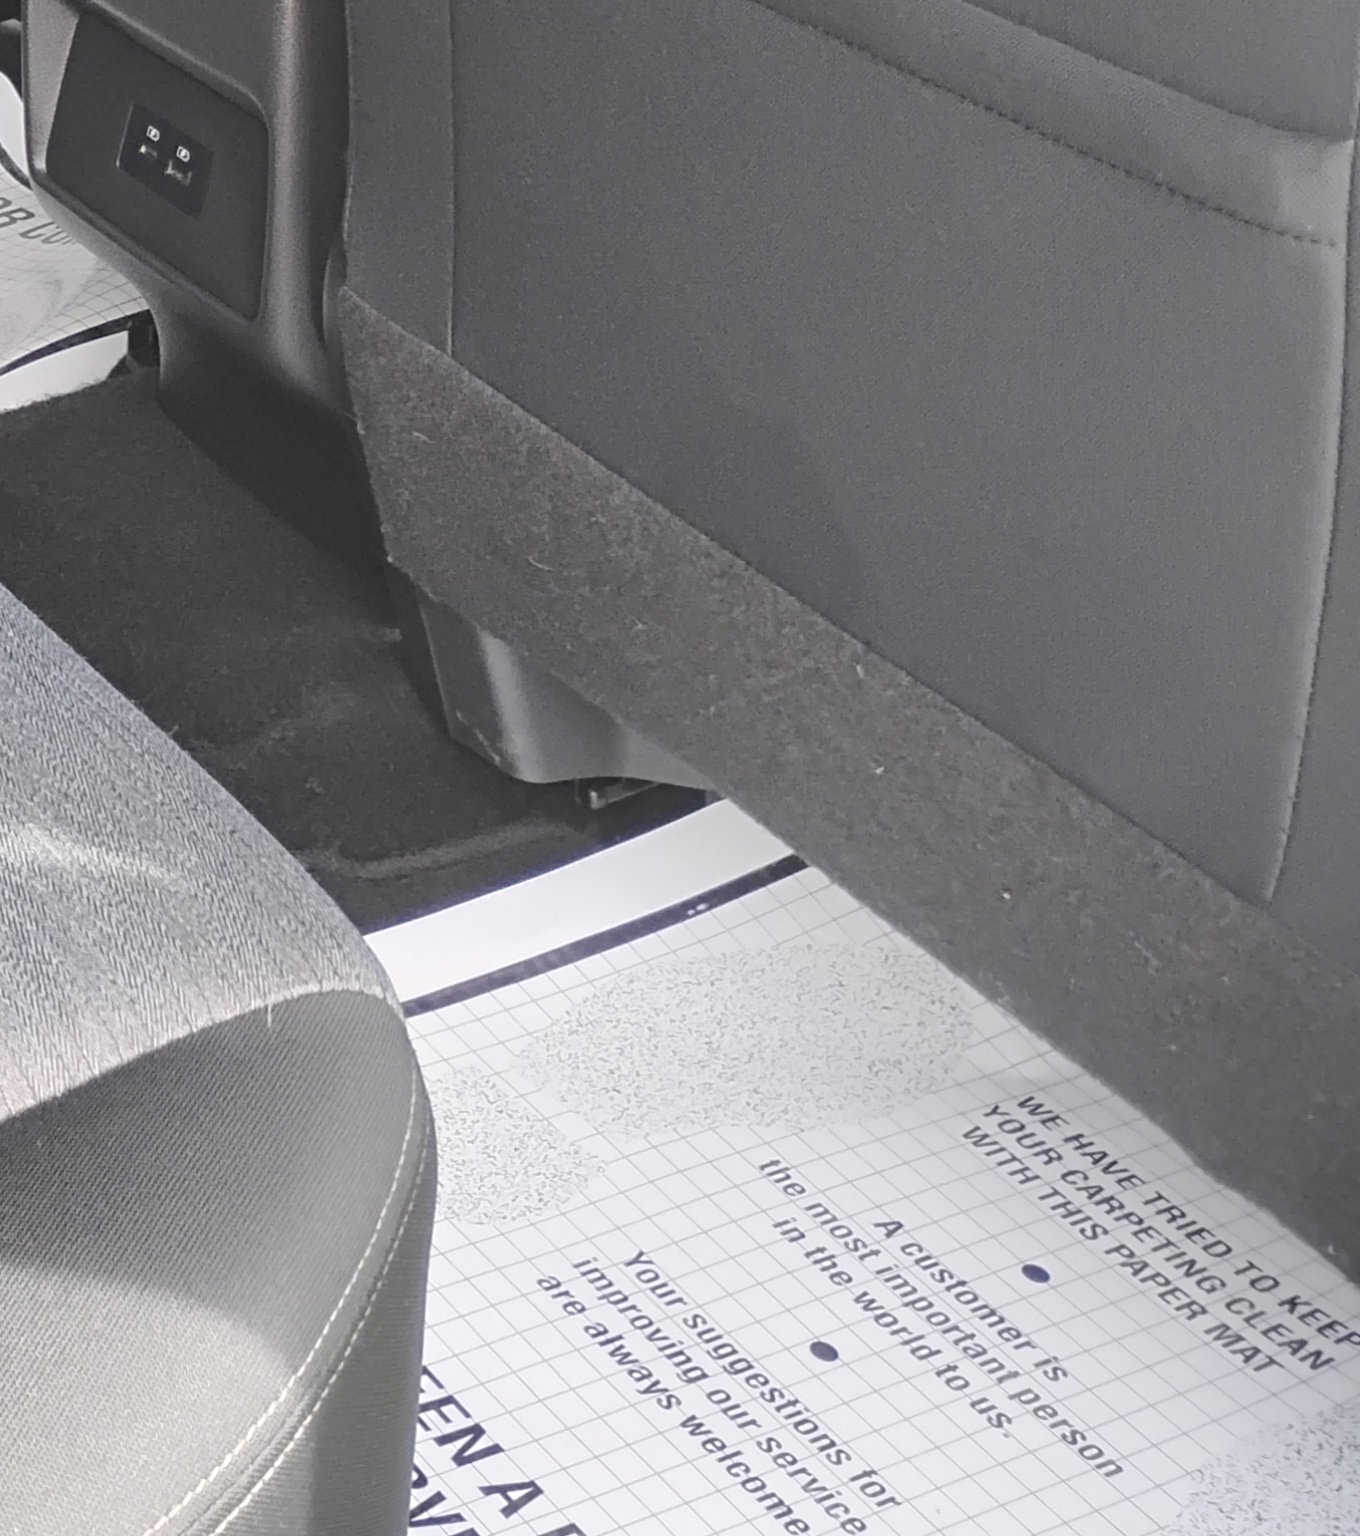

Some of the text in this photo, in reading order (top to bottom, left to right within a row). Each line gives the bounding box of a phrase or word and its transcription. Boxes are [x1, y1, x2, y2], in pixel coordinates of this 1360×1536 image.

[757, 1158, 1126, 1479] the most important person
[771, 1216, 1014, 1439] in the world to us.
[872, 1218, 1069, 1383] A customer is
[960, 1124, 1286, 1374] WITH THIS PAPER MAT
[982, 1104, 1338, 1373] YOUR CARPETING CLEAN
[1015, 1095, 1360, 1349] WE HAVE TRIED TO KEEP
[477, 1479, 545, 1520] A
[535, 1274, 811, 1536] are always welcome
[571, 1255, 868, 1536] improving our service
[621, 1249, 903, 1511] Your suggestions for
